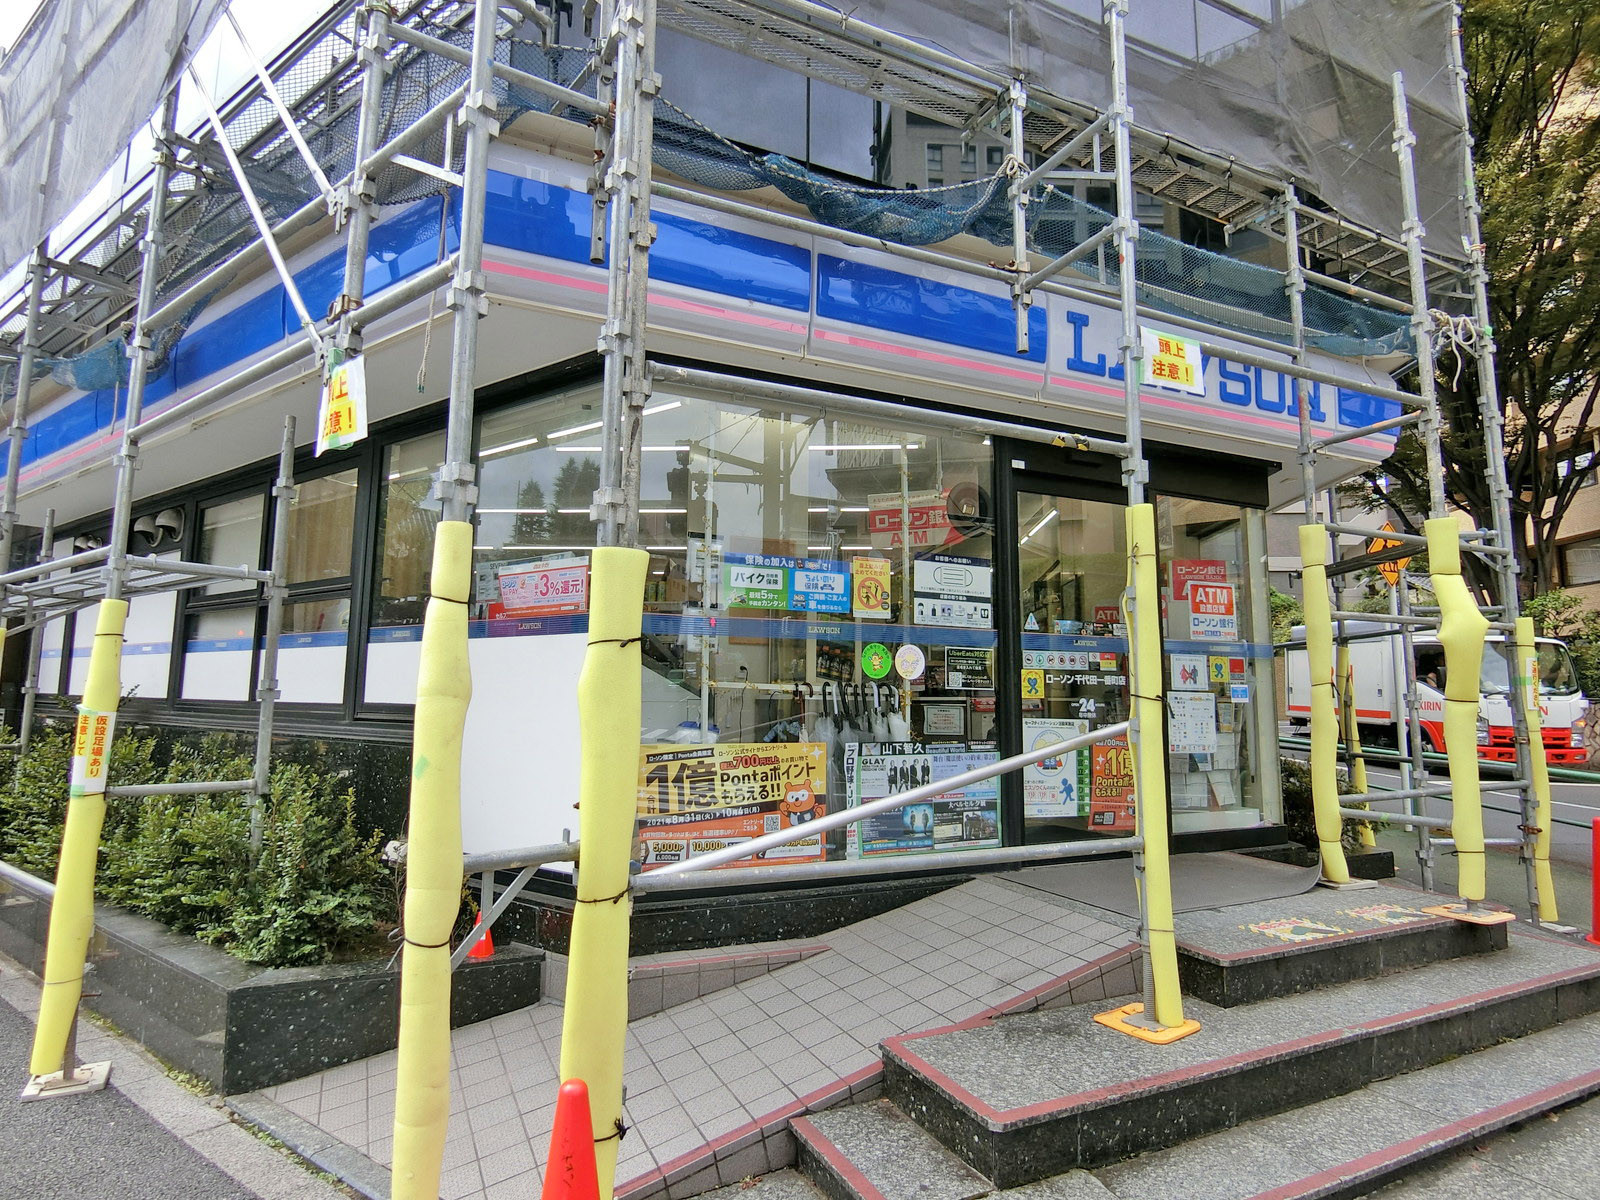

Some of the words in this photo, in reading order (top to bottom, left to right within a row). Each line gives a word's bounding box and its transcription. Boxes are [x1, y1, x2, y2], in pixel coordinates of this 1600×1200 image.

[1158, 338, 1185, 359] 頭上
[1067, 310, 1326, 422] LSON
[322, 407, 352, 438] 意!
[745, 554, 795, 568] 保険の加入は
[1177, 566, 1224, 574] ローソン銀行
[735, 572, 765, 584] バイク
[1195, 587, 1228, 604] ATM
[808, 626, 841, 634] LAWSON
[1192, 617, 1234, 629] ローソン銀行
[1046, 674, 1126, 686] ローソン千代田一番町店
[1079, 698, 1096, 712] 24
[77, 714, 90, 756] 注意して
[90, 715, 108, 777] 仮設足場あり
[882, 742, 924, 755] 山下智久
[720, 762, 816, 788] Pontaポイント
[720, 783, 780, 805] もらえる!!
